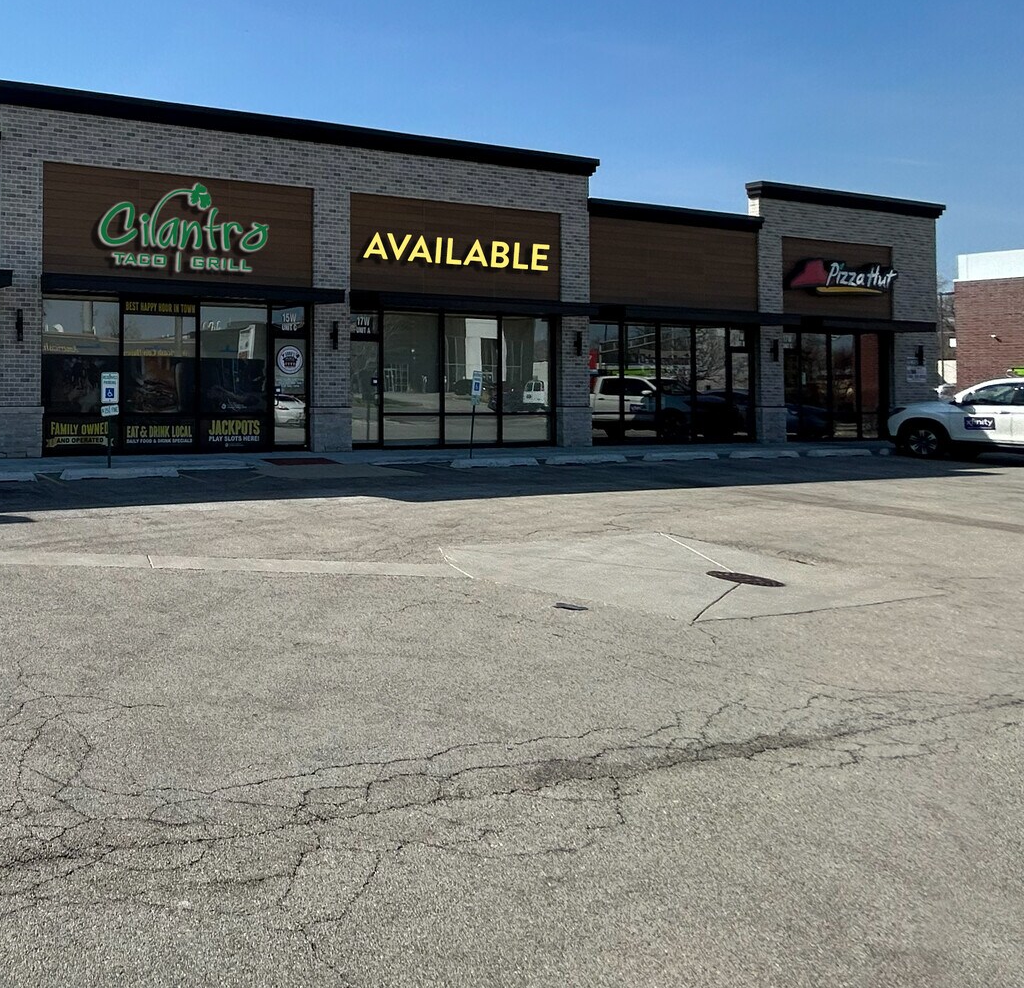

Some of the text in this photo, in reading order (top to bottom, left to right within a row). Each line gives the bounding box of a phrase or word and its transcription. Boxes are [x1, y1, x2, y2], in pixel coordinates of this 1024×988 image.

[98, 184, 269, 252] Cilantro
[363, 232, 550, 272] AVAILABLE
[112, 252, 253, 272] TACO GRILL
[826, 262, 897, 288] Pizza Hut
[125, 301, 196, 314] BEST HAPPY HOUR IN TOWN
[282, 313, 296, 323] 15W
[50, 421, 109, 435] FAMILY OWNED
[126, 425, 193, 438] EAT & DRINK LOCAL
[208, 419, 261, 436] JACKPOTS
